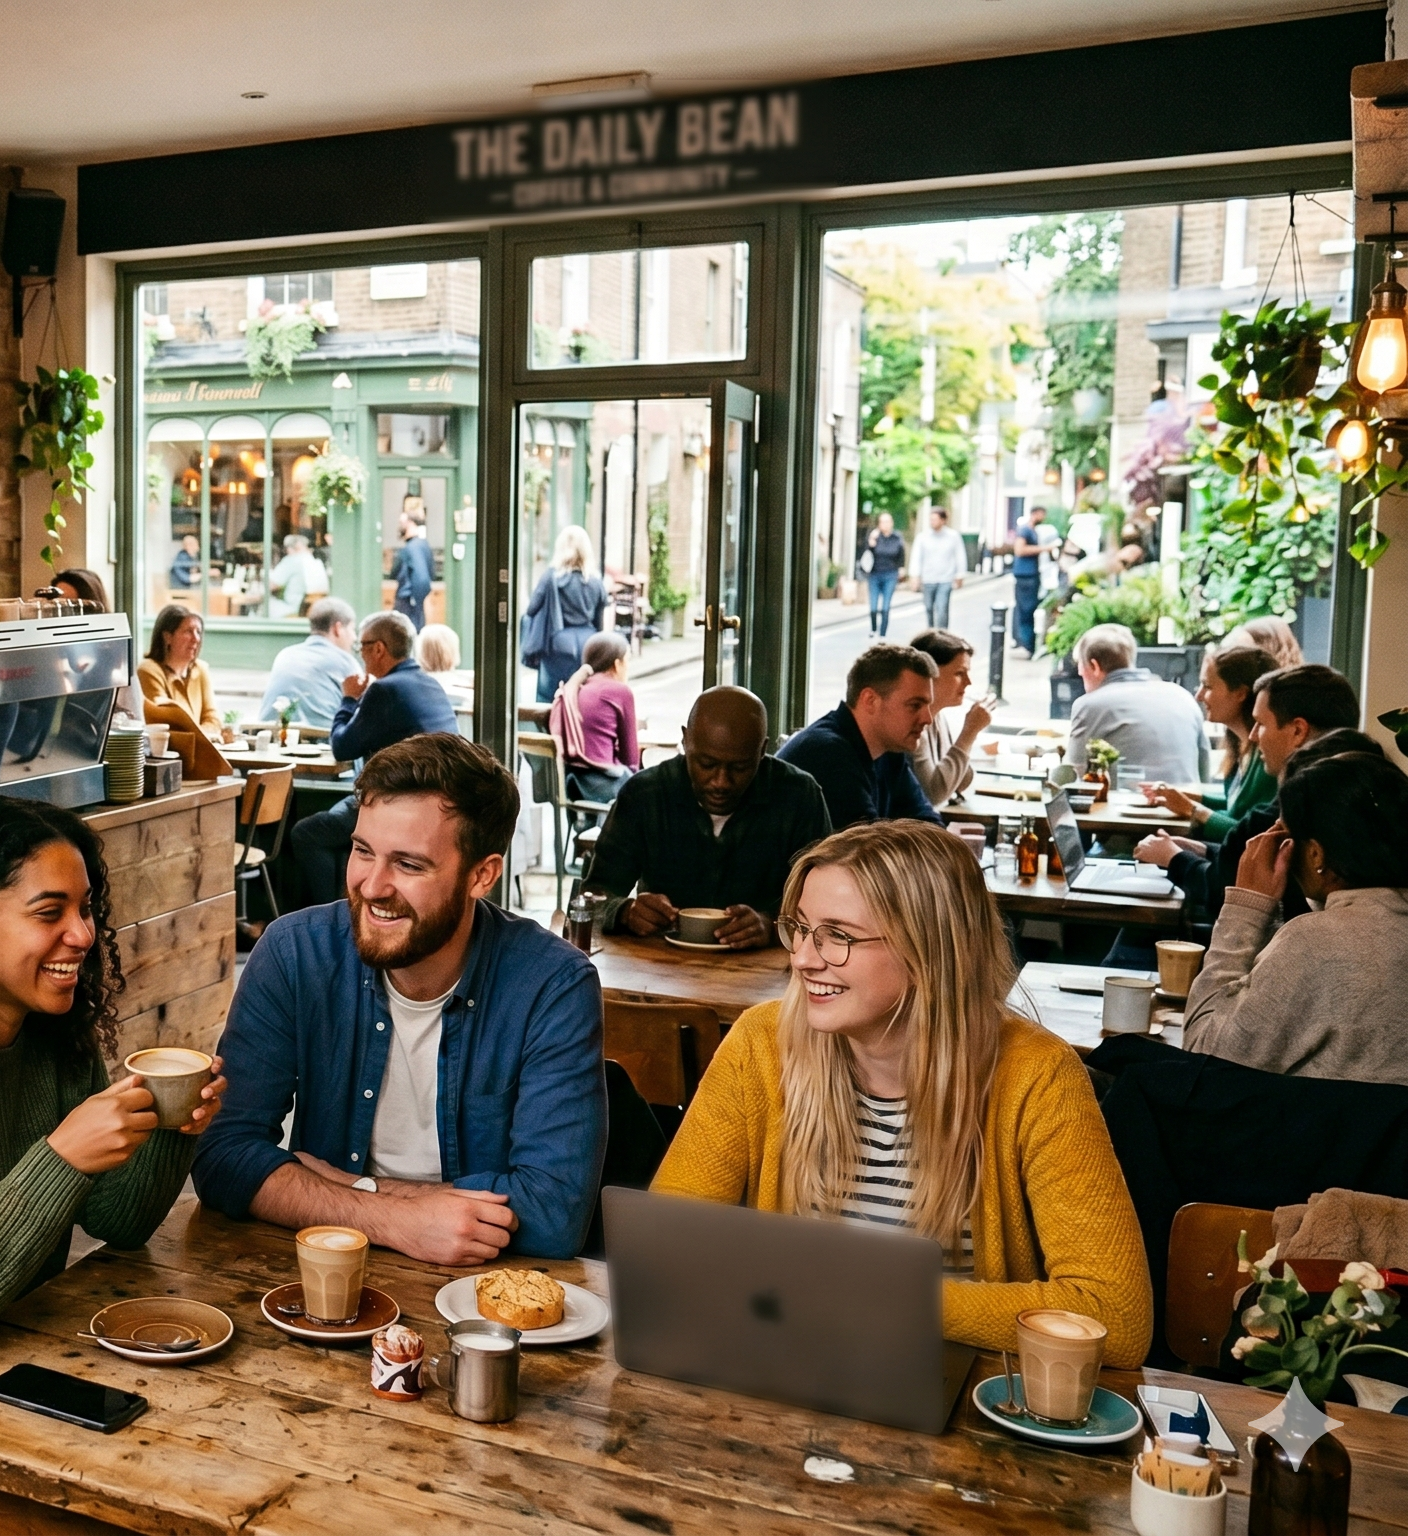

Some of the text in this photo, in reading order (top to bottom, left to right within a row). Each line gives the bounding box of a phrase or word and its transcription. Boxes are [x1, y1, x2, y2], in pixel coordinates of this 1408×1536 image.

[453, 94, 798, 180] THE DAILY BEAN
